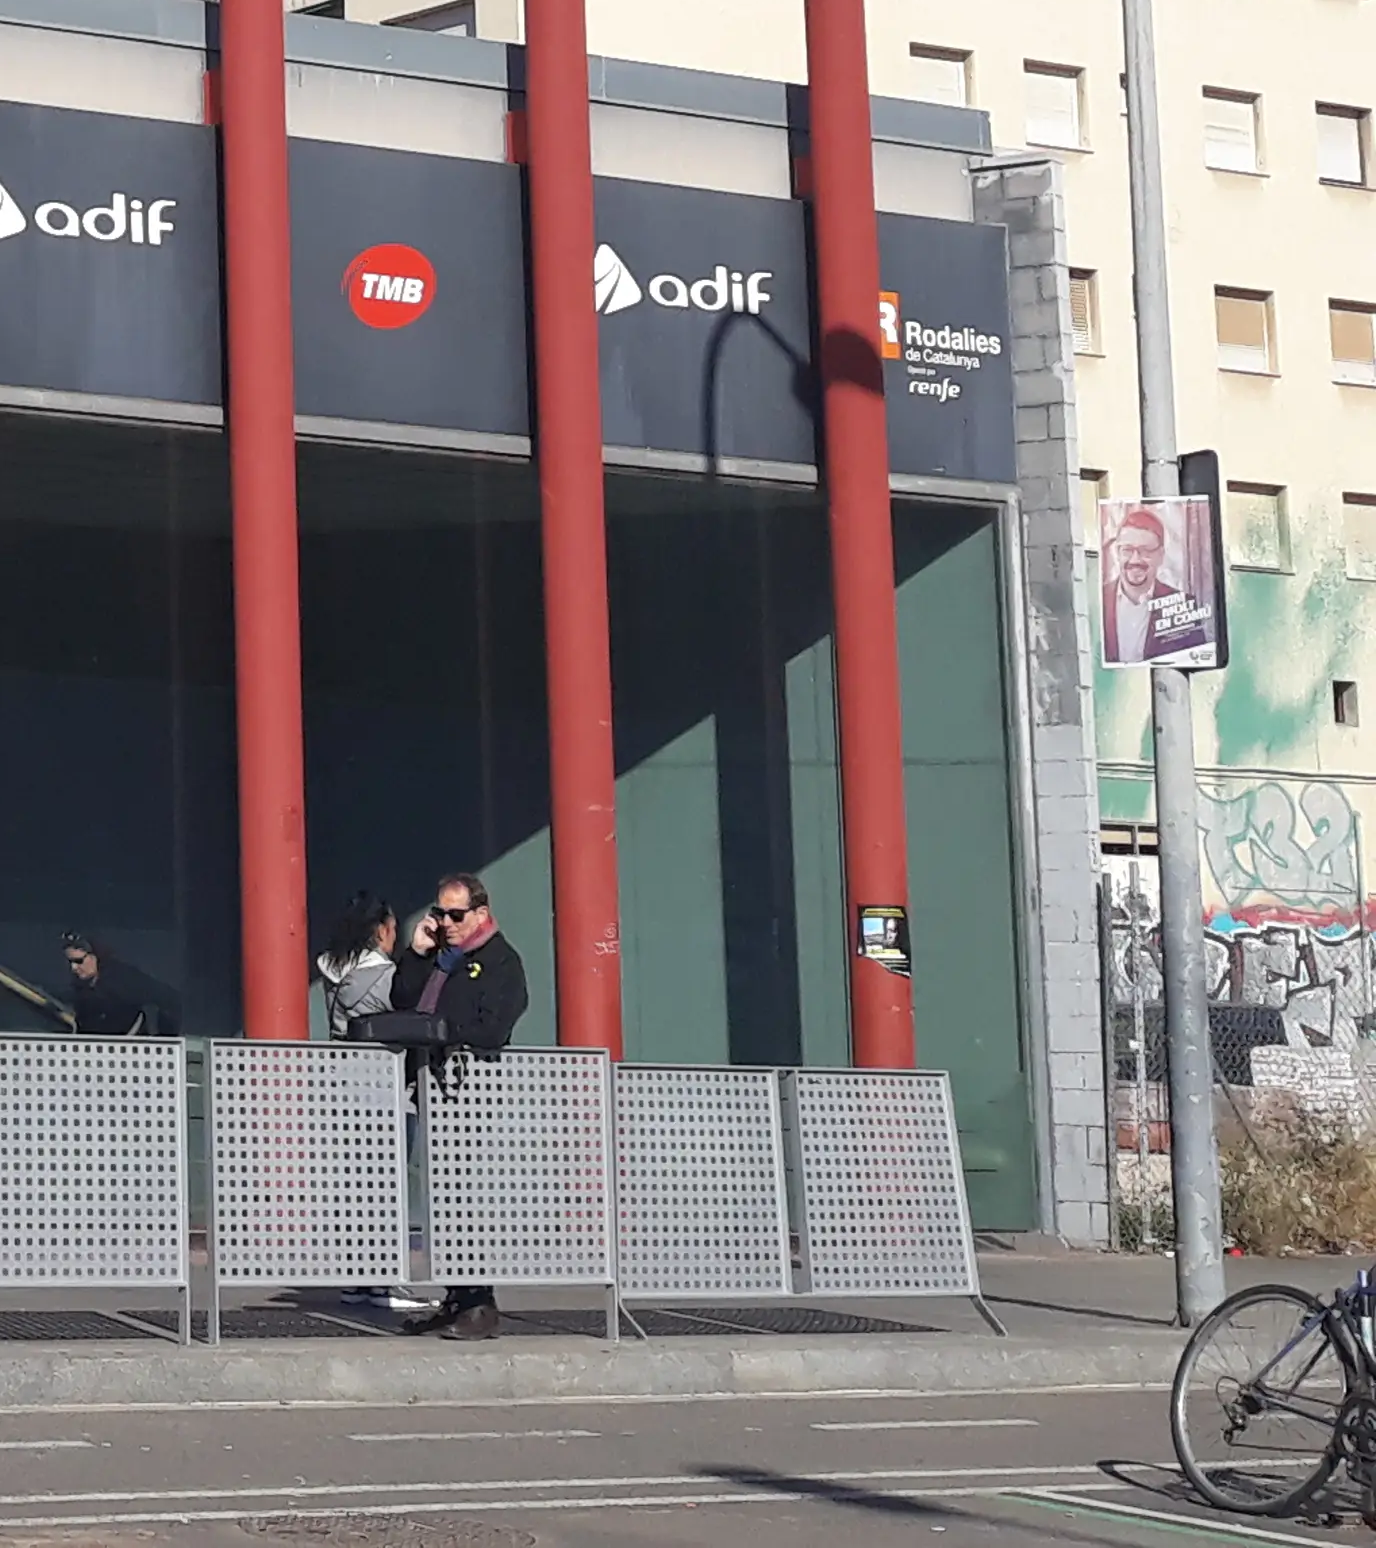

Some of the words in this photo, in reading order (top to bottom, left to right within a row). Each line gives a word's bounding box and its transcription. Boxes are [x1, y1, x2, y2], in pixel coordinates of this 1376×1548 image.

[33, 192, 177, 246] adif
[361, 272, 424, 304] TMB
[649, 265, 773, 315] adif
[905, 320, 1002, 355] Rodalies
[905, 347, 921, 362] de
[922, 348, 981, 371] Catalunya
[909, 377, 961, 403] renfe
